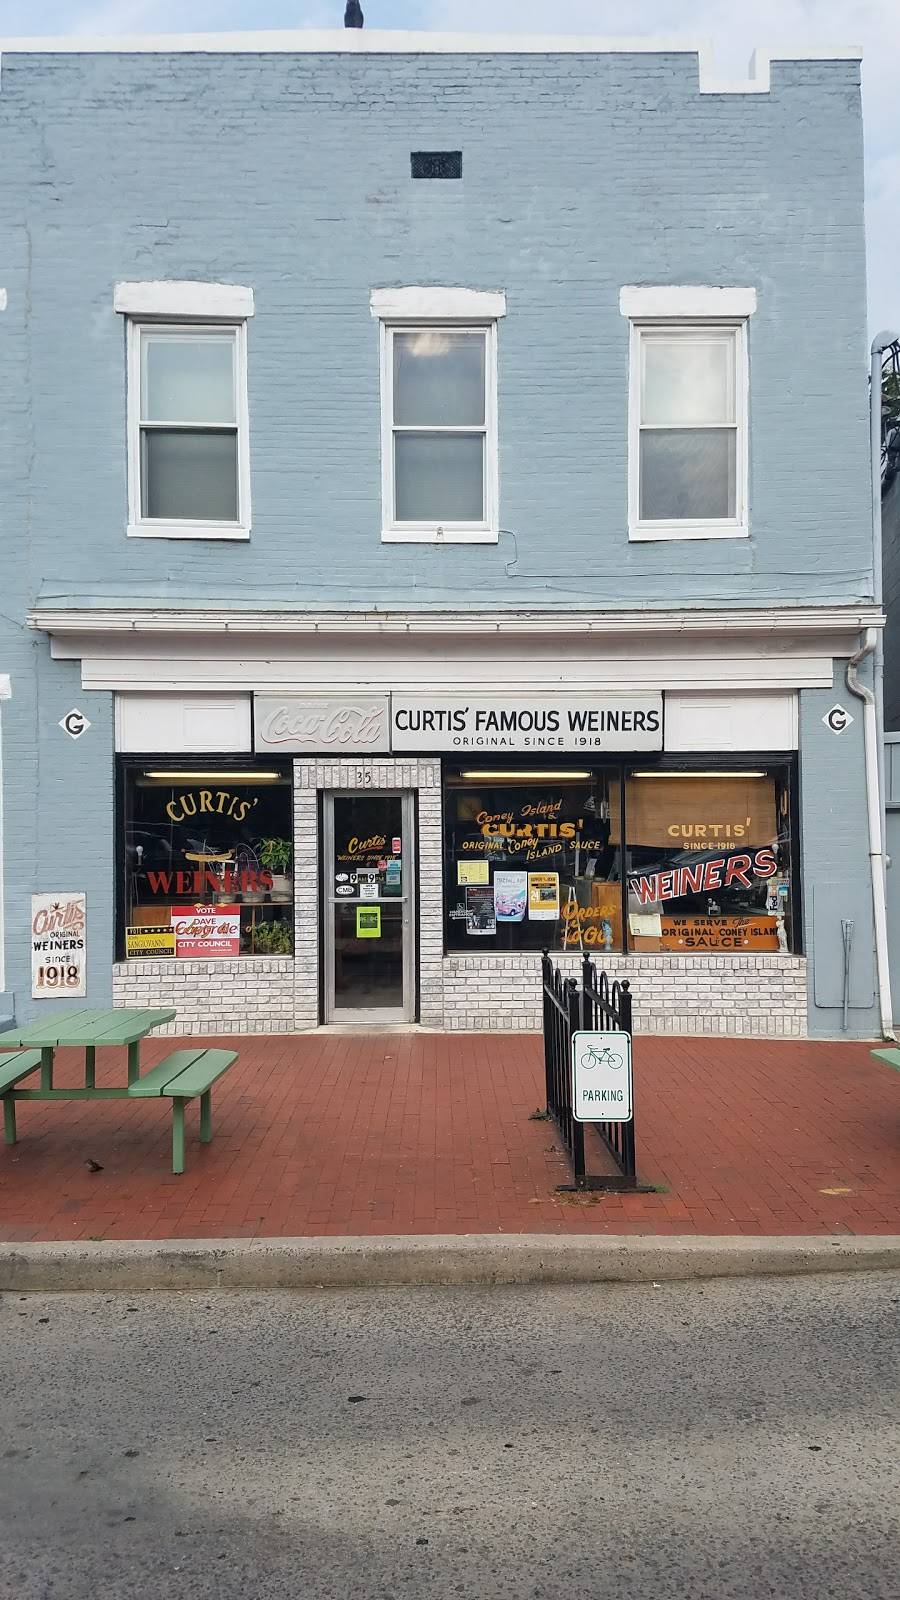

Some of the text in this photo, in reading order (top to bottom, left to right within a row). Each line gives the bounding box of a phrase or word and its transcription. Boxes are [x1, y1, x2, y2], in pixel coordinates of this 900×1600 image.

[65, 713, 84, 735] G
[395, 707, 660, 732] CURTIS' FAMOUS WEINERS
[828, 709, 847, 731] G
[453, 737, 601, 746] ORIGINAL SINCE 1918
[356, 771, 372, 784] 35
[166, 790, 258, 822] CURTIS'
[476, 799, 562, 824] Coney Island
[482, 818, 584, 838] CURTIS'
[667, 817, 751, 837] CURTIS'
[462, 837, 601, 860] ORIGINAL Coney ISLAND SAUCE
[683, 842, 736, 850] SINCE 1918
[147, 869, 275, 895] WEINERS
[368, 873, 375, 883] 9
[630, 850, 777, 906] WEINERS
[50, 931, 80, 939] ORIGINAL
[662, 928, 715, 937] ORIGINAL
[719, 928, 749, 937] CONEY
[685, 937, 744, 948] SAUCE
[33, 939, 84, 951] WEINERS
[198, 940, 233, 948] COUNCIL
[36, 965, 80, 989] 1918
[582, 1089, 624, 1102] PARKING
